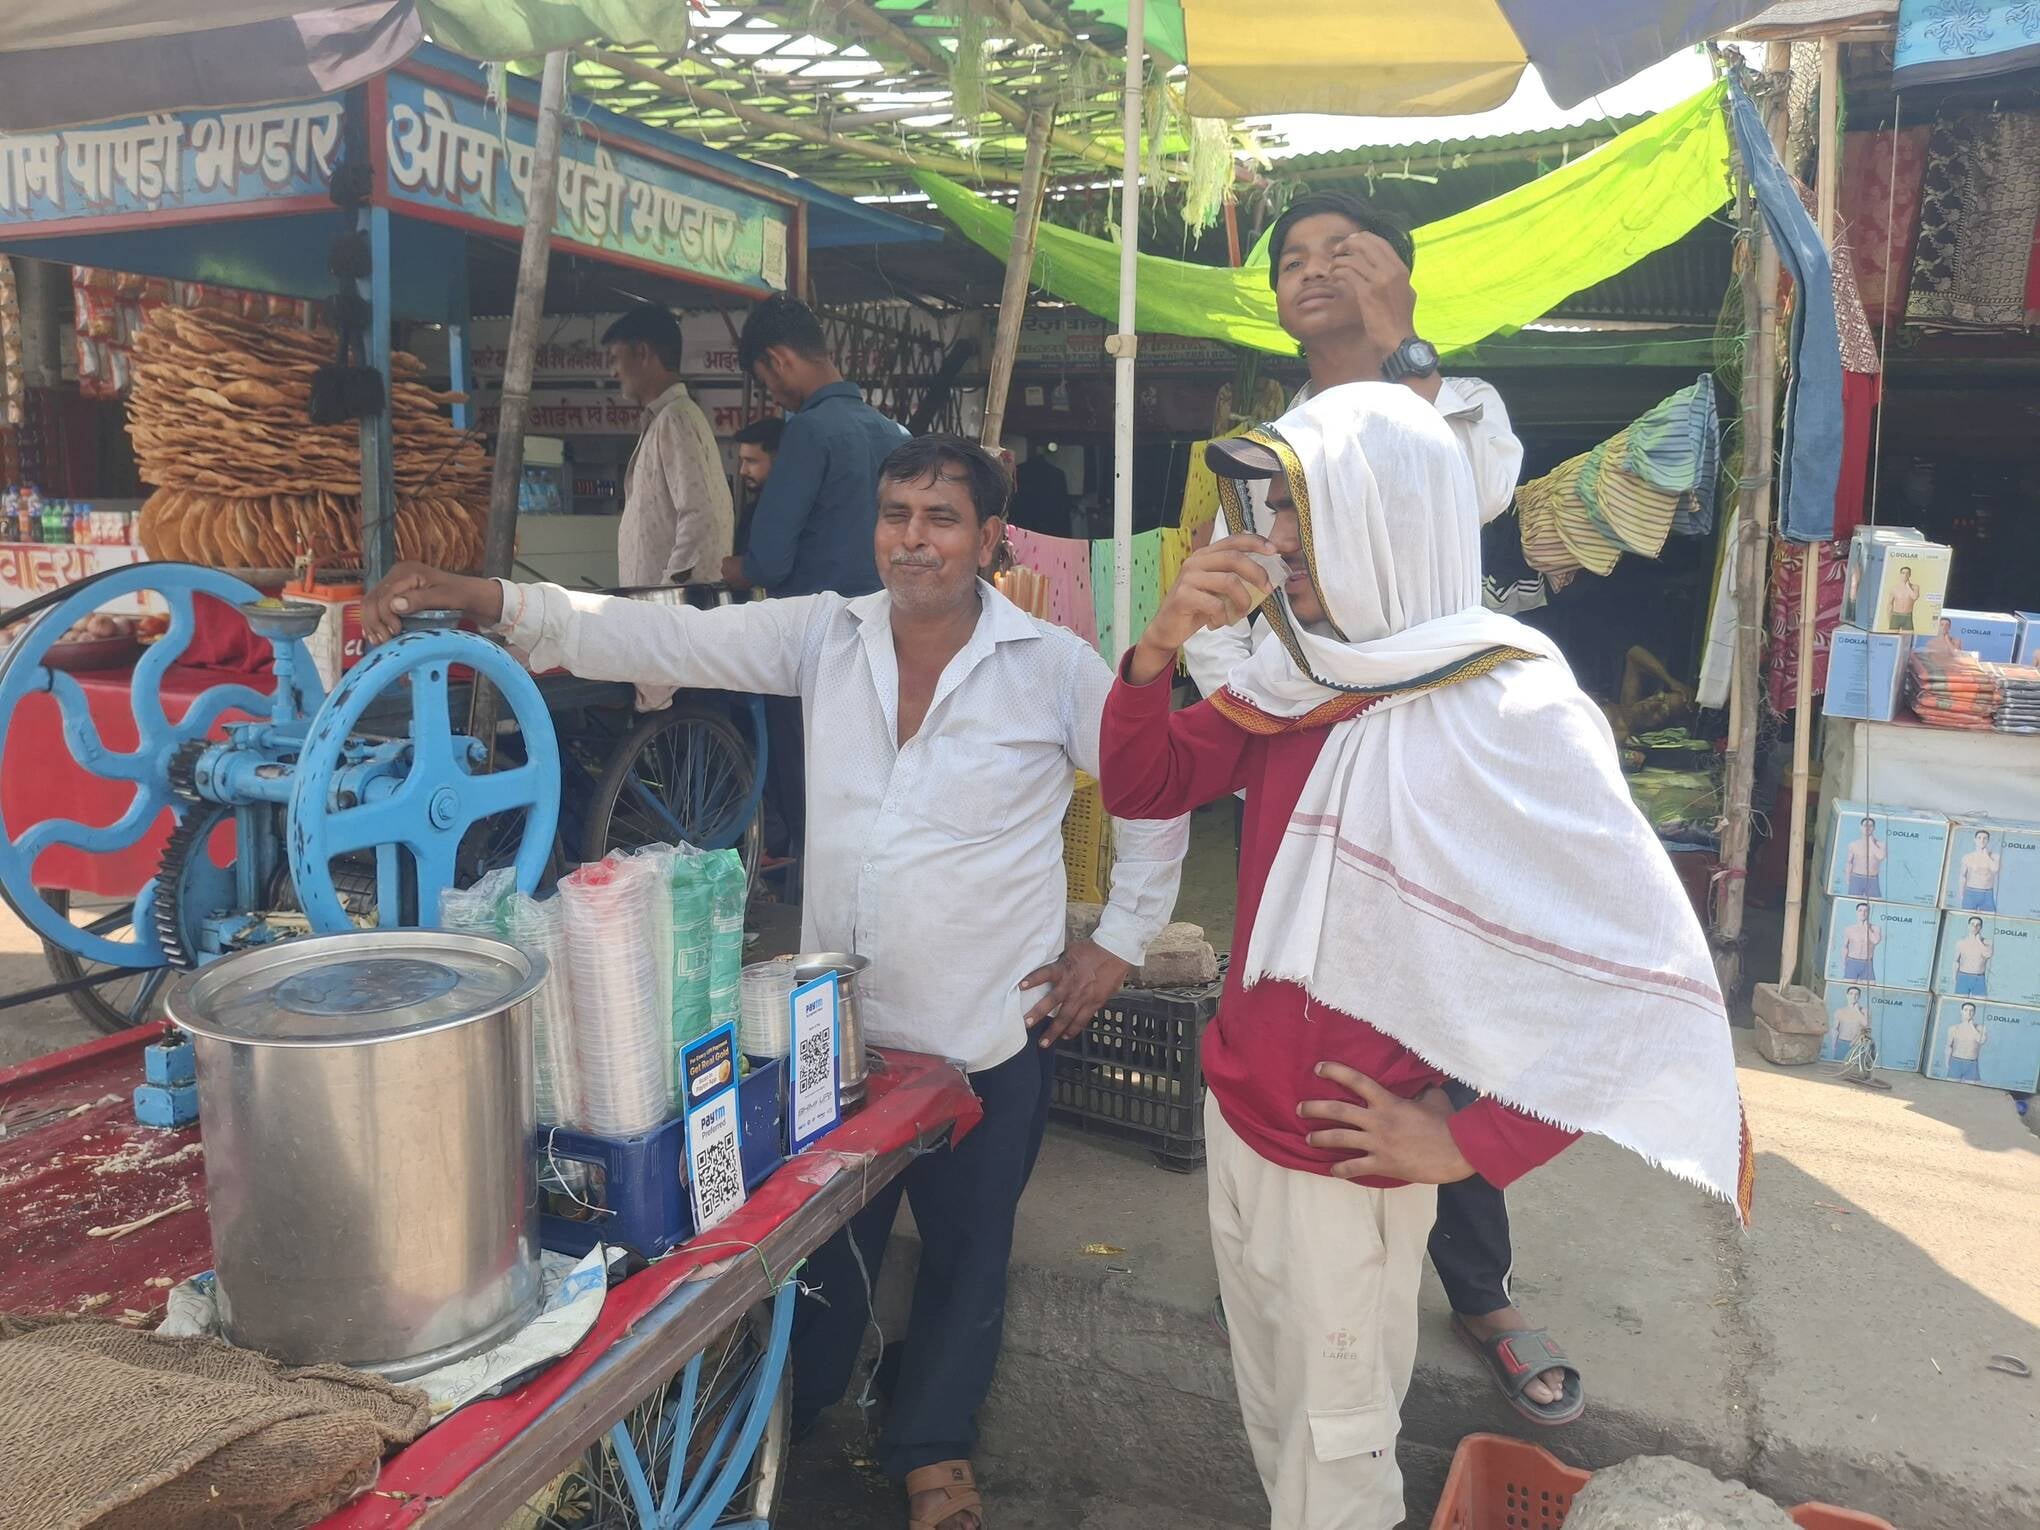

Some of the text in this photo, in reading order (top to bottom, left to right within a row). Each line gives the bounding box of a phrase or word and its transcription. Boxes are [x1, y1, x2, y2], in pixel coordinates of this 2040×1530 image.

[192, 101, 344, 194] भण्डार
[386, 88, 503, 207] ओम
[503, 139, 627, 248] पपड़ी
[630, 182, 738, 274] भण्डार
[1893, 830, 1919, 839] DOLLAR
[2008, 842, 2036, 850] DOLLAR
[1887, 915, 1912, 923] DOLLAR
[2000, 929, 2028, 938] DOLLAR
[1878, 998, 1903, 1006] DOLLAR
[1993, 1015, 2020, 1024] DOLLAR
[715, 1046, 729, 1060] Gold
[702, 1119, 727, 1139] Preferred
